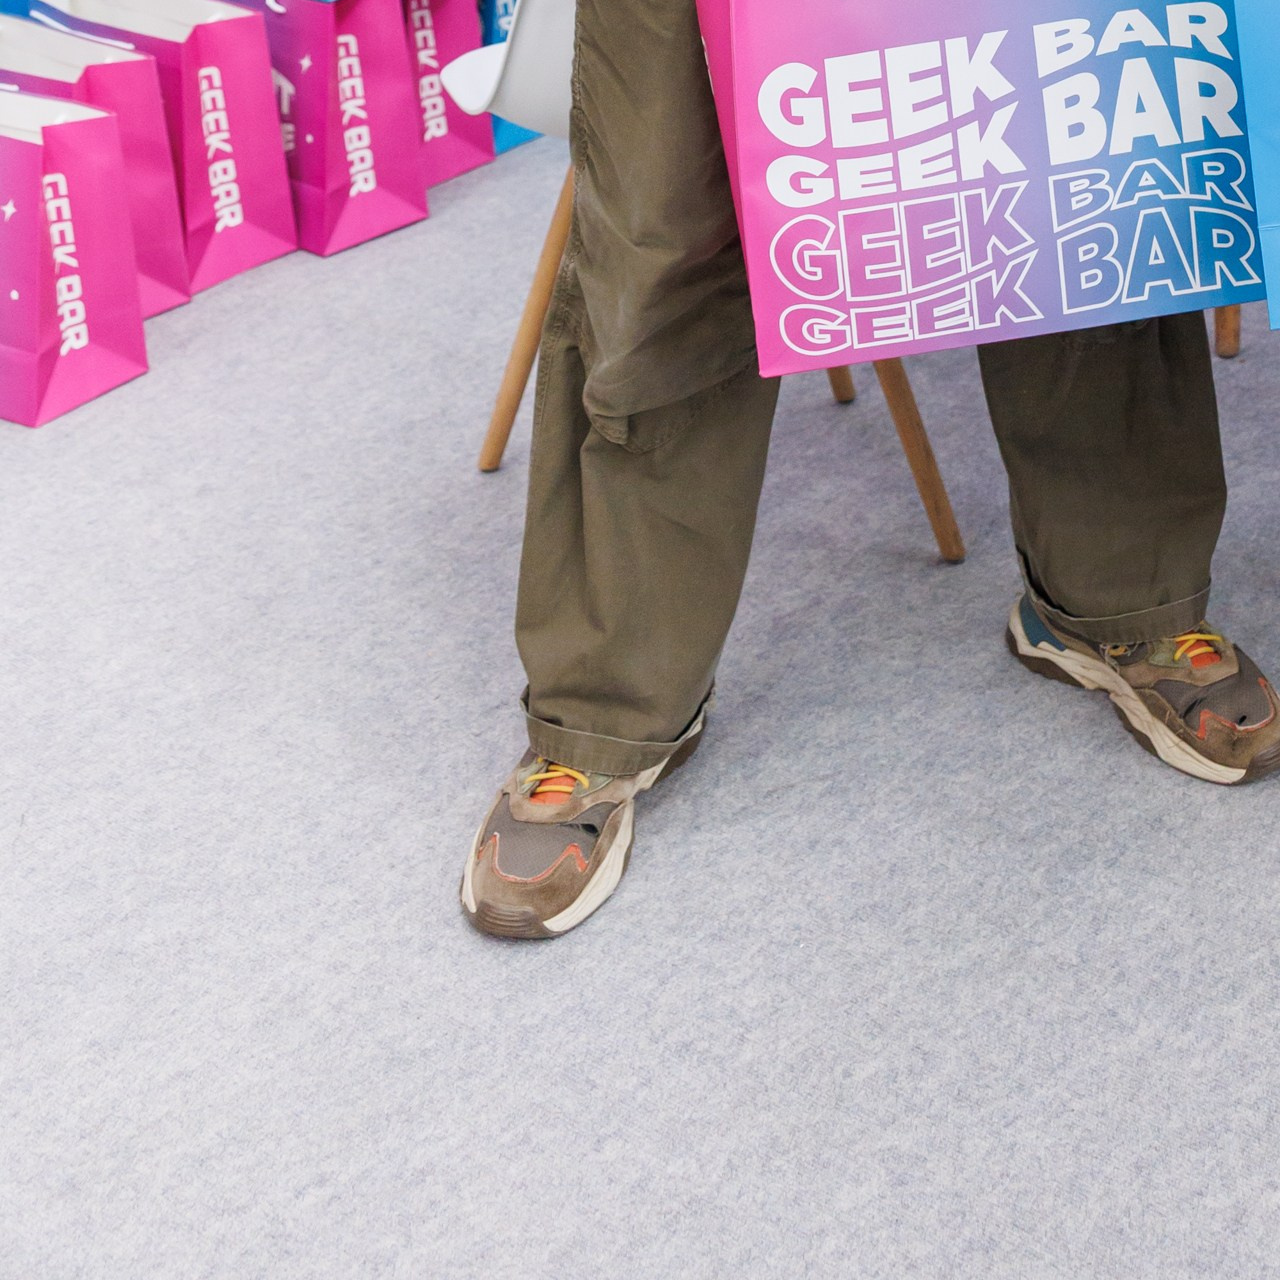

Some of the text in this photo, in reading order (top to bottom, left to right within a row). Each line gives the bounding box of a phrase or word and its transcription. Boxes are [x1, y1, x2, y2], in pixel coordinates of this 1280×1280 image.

[198, 65, 244, 233] GEEK BAR
[337, 33, 377, 197] GEEK BAR
[419, 73, 449, 142] BAR
[757, 1, 1233, 148] GEEK BAR
[765, 56, 1244, 208] GEEK BAR
[769, 148, 1254, 301] GEEK BAR
[779, 206, 1262, 356] GEEK BAR
[56, 273, 89, 357] BAR
